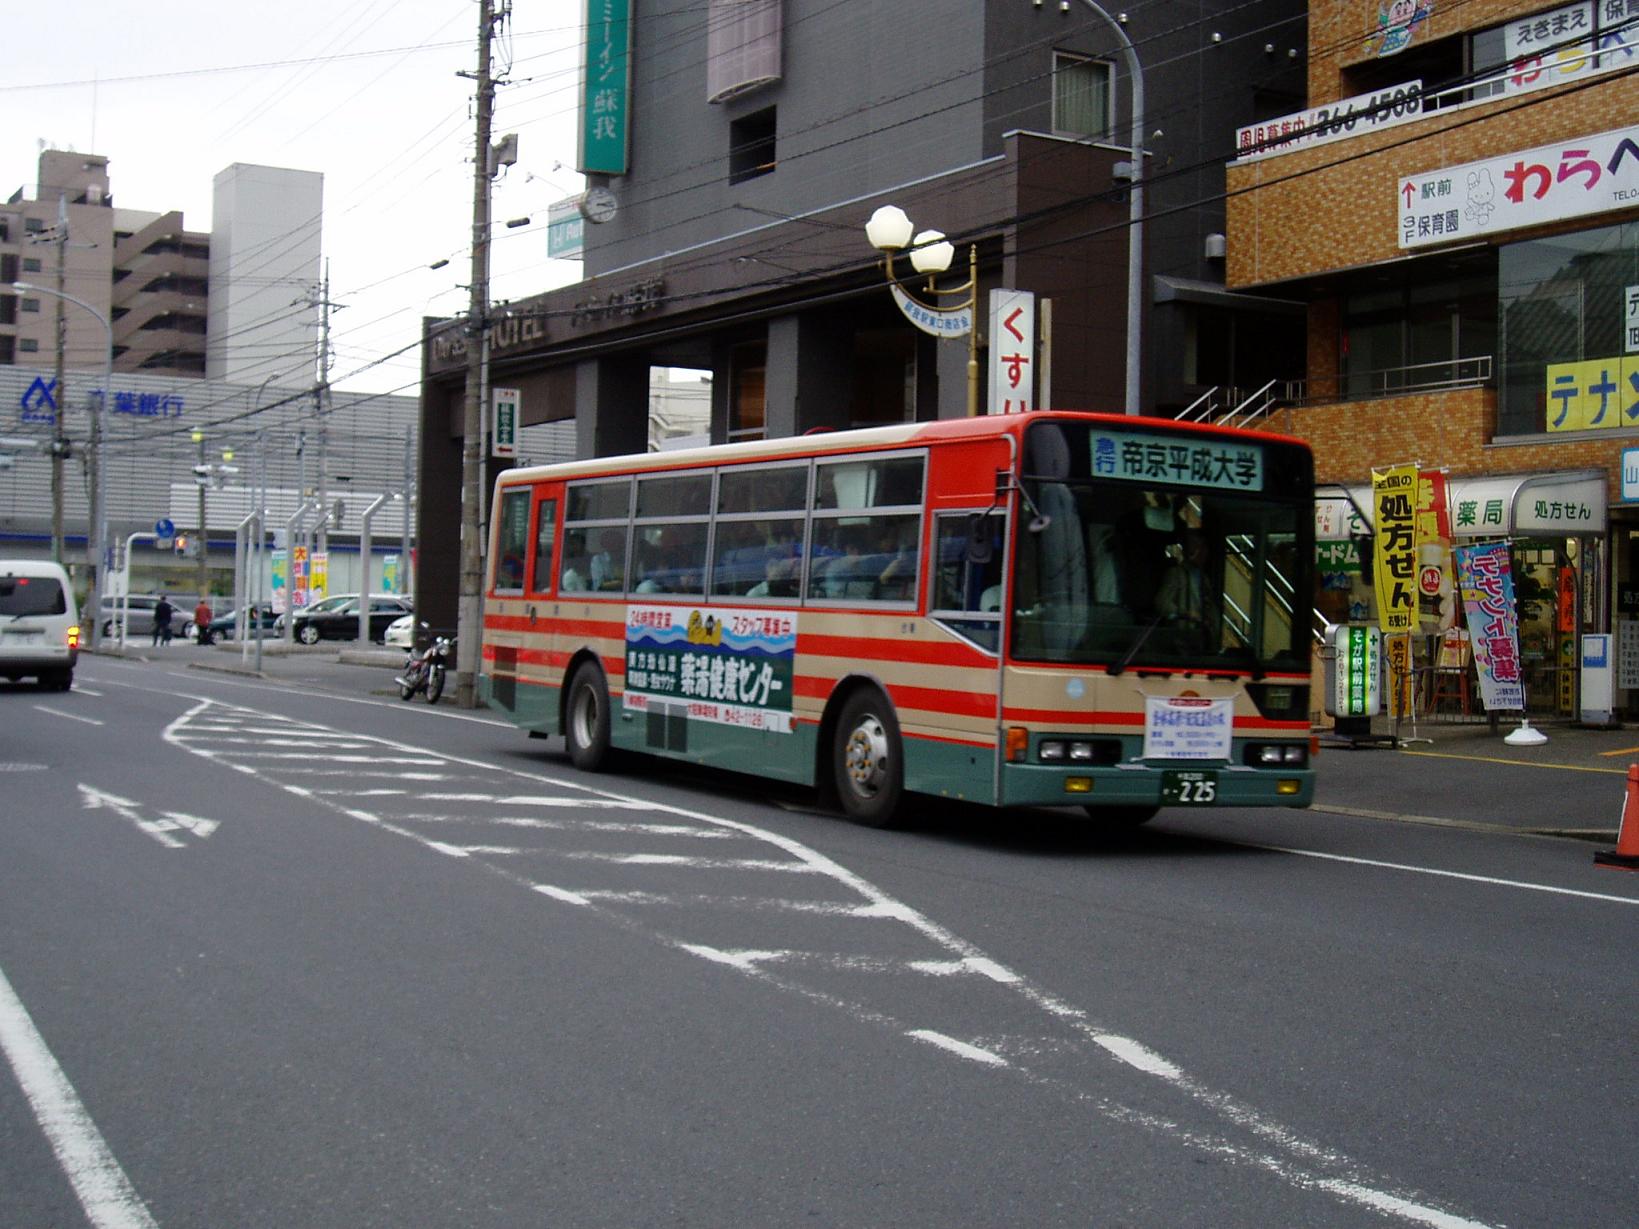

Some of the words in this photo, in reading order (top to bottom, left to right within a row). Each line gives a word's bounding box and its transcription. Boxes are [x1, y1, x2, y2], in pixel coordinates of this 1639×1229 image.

[1516, 8, 1589, 46] えきまえ
[592, 89, 619, 140] 蘇我
[1421, 179, 1452, 199] 駅前
[1418, 209, 1460, 238] 保育園
[1096, 437, 1116, 473] 急行
[1122, 441, 1257, 486] 帝京平成大学
[1456, 499, 1503, 526] 薬局
[1535, 500, 1592, 520] 処方せん
[1379, 494, 1415, 609] 処方せん
[732, 615, 791, 637] スタッフ募集中
[680, 651, 783, 705] 薬湯健康センター
[1351, 630, 1363, 712] そが駅前薬局
[1179, 781, 1216, 802] 225
